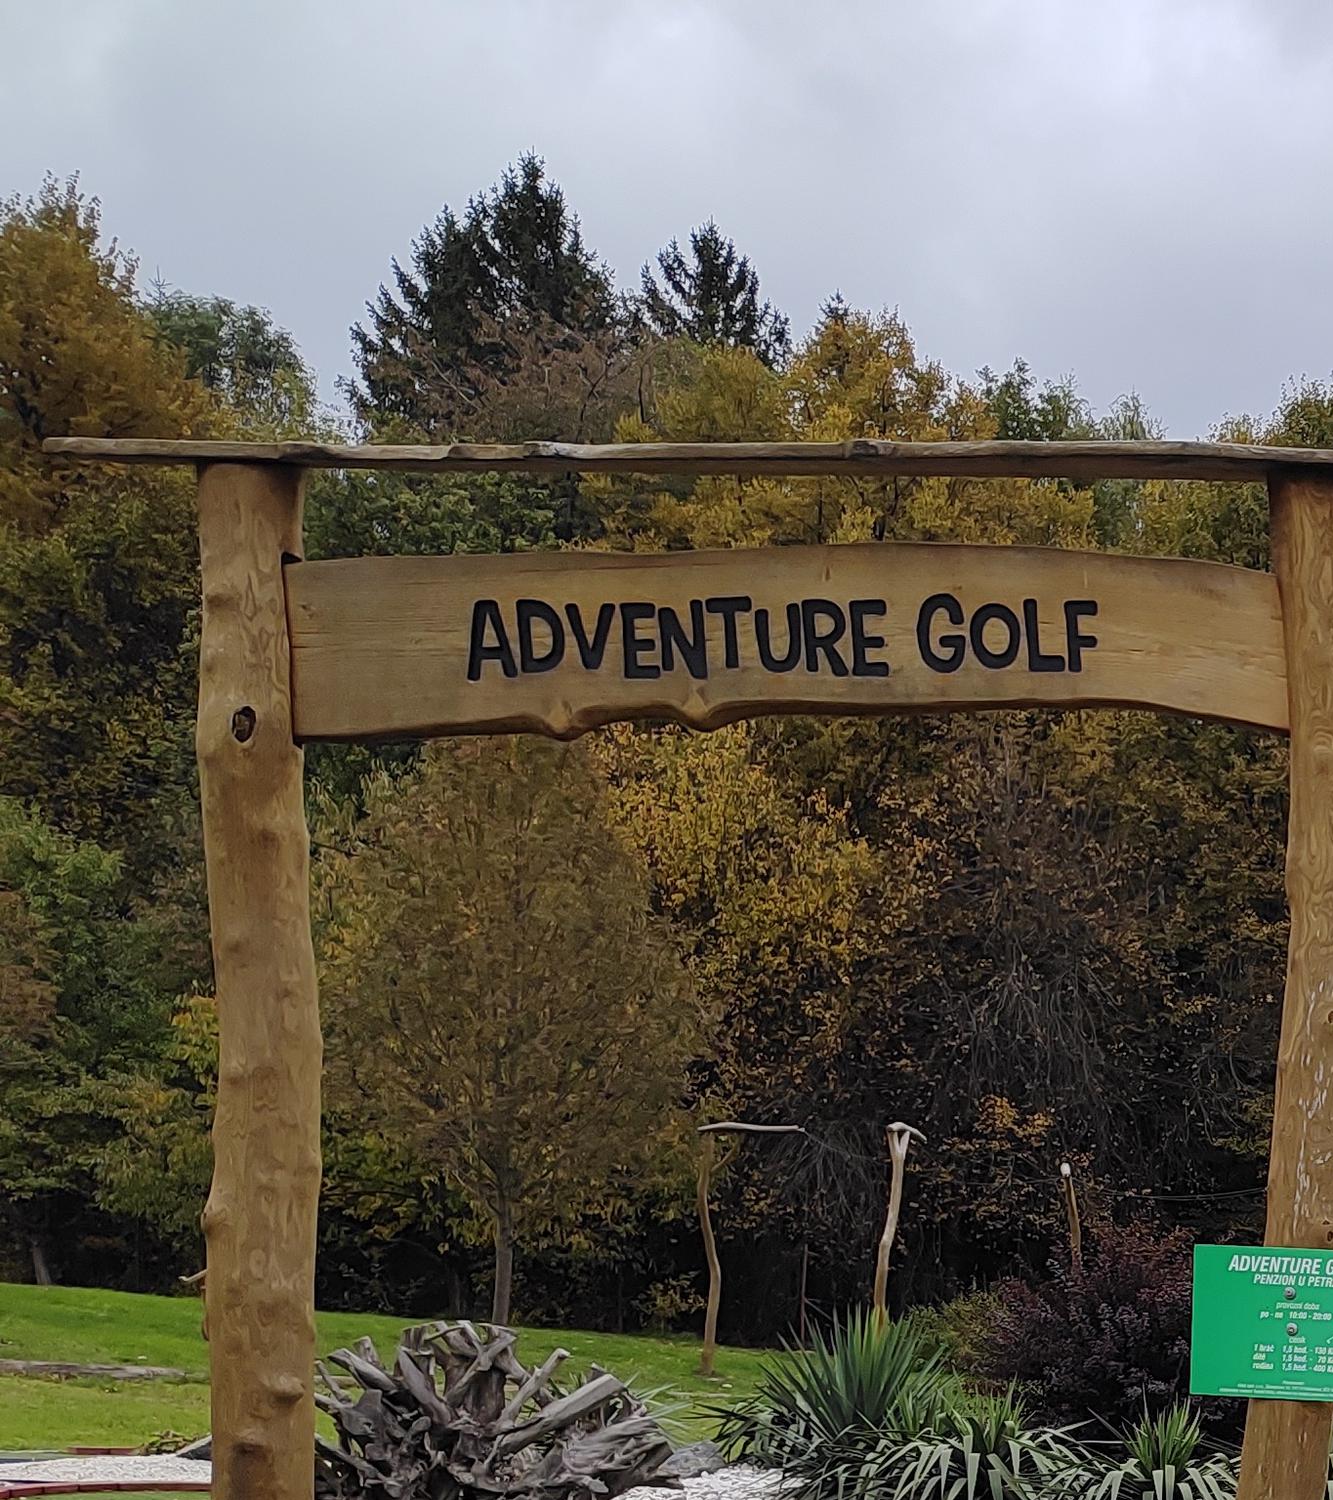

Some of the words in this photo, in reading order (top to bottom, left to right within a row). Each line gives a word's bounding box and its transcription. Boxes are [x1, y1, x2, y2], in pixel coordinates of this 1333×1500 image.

[466, 596, 890, 681] ADVENTURE
[915, 593, 1098, 674] GOLF
[1228, 1255, 1322, 1275] ADVENTURE
[1253, 1273, 1296, 1286] PENZION
[1298, 1275, 1306, 1286] U
[1260, 1311, 1269, 1319] po
[1289, 1311, 1307, 1319] 10:00
[1312, 1312, 1332, 1320] 20:00
[1313, 1364, 1327, 1373] 400
